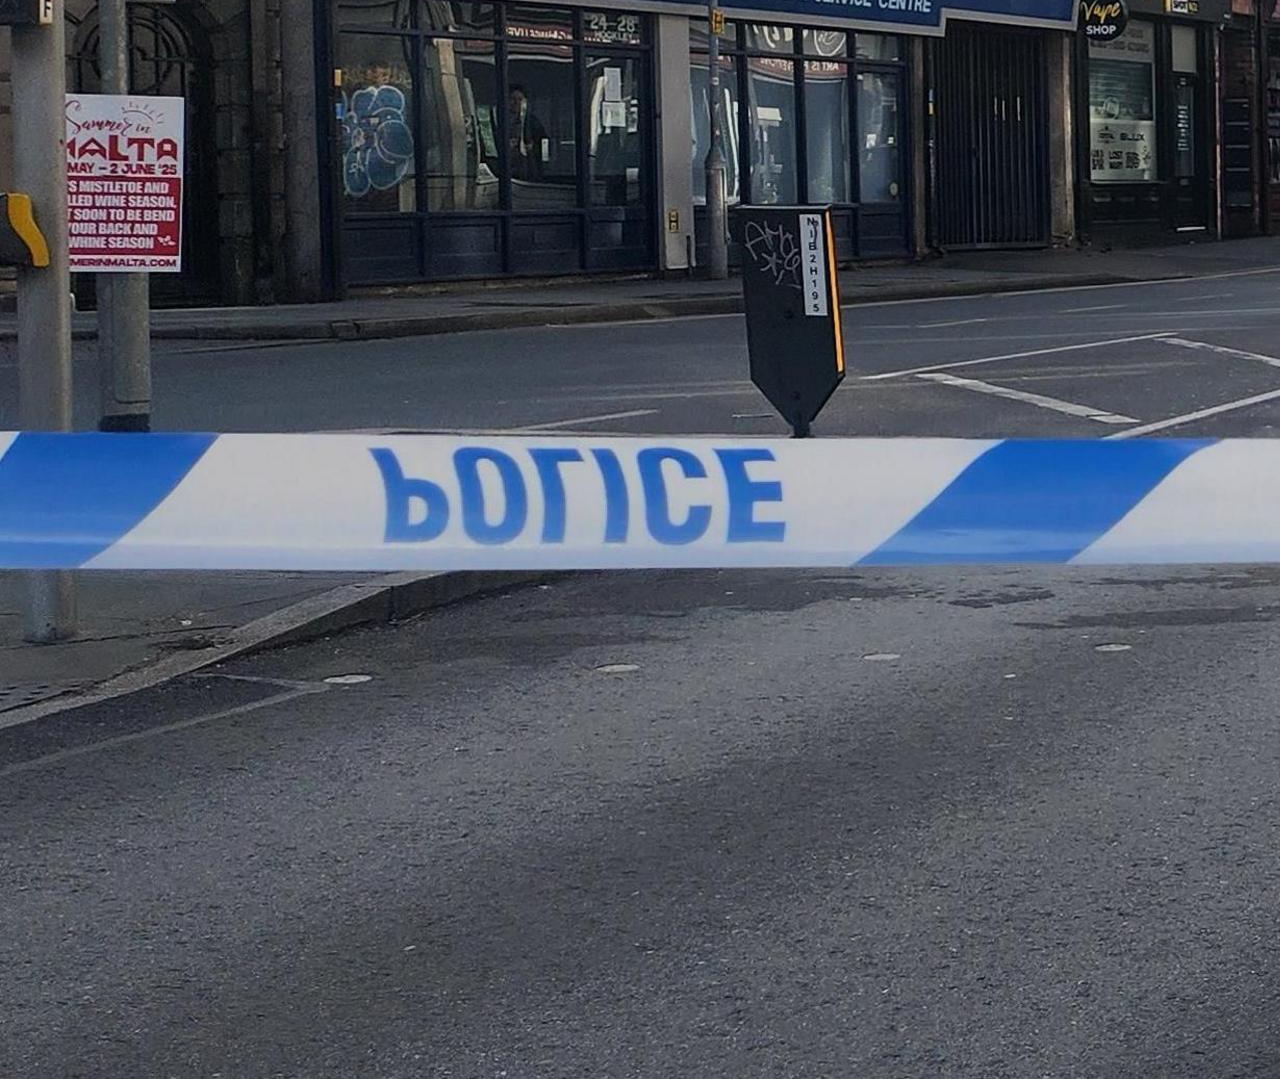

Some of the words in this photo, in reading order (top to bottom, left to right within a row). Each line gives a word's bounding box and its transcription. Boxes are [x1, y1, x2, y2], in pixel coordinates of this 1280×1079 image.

[1081, 0, 1121, 23] Vape
[1086, 25, 1117, 35] SHOP
[110, 163, 119, 174] 2
[122, 163, 155, 175] JUNE
[79, 181, 143, 194] MISTLETOE
[145, 181, 169, 194] AND
[94, 195, 126, 207] WINE
[74, 208, 107, 220] SOON
[109, 209, 125, 221] TO
[127, 209, 142, 221] BE
[144, 209, 175, 222] BEND
[98, 222, 132, 235] BACK
[133, 223, 158, 235] AND
[109, 236, 154, 249] SEASON
